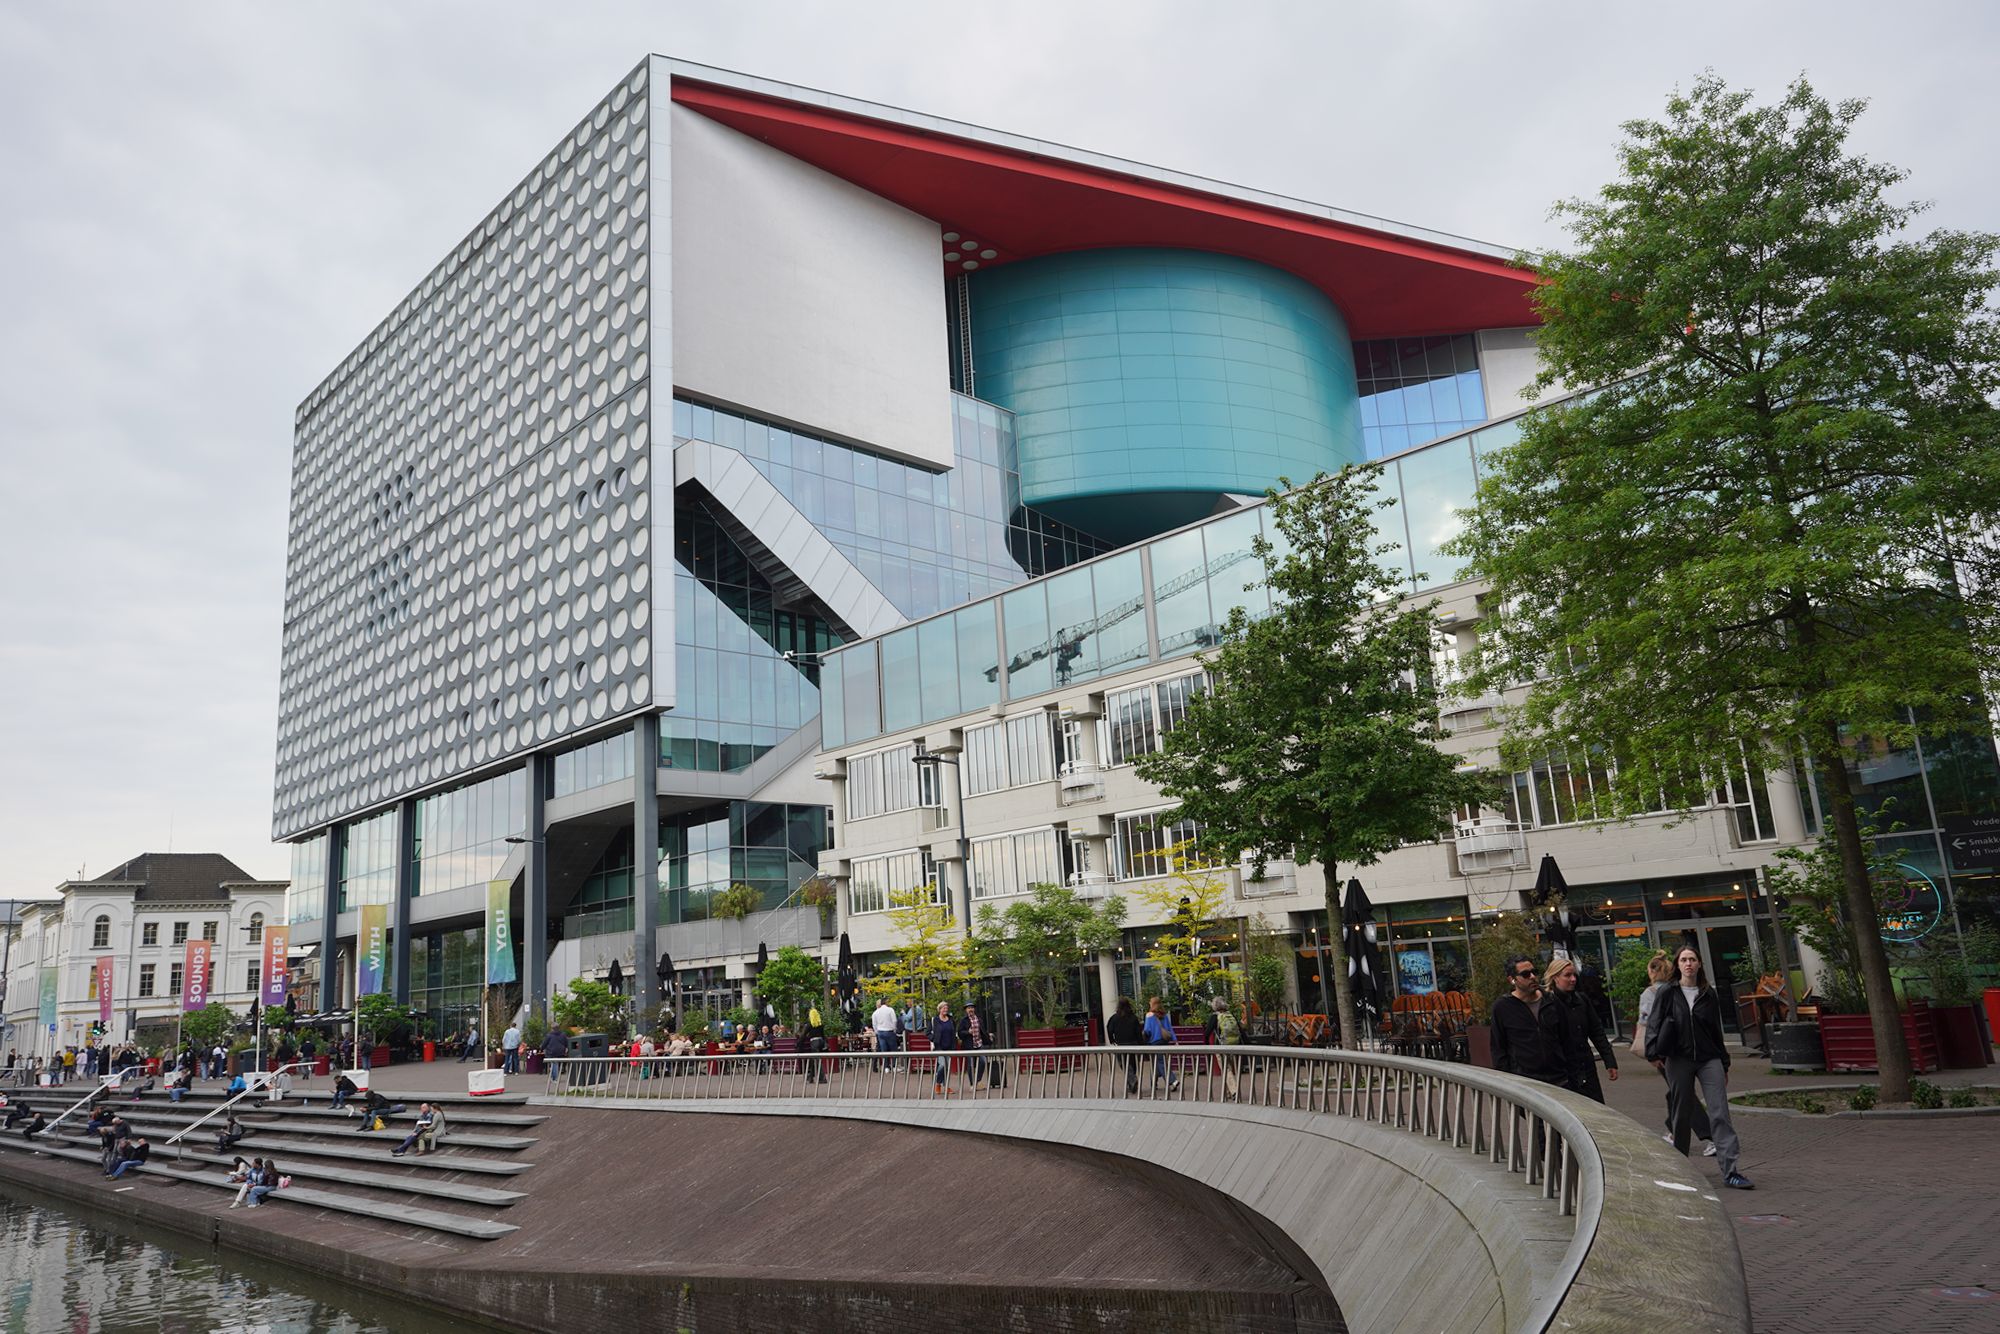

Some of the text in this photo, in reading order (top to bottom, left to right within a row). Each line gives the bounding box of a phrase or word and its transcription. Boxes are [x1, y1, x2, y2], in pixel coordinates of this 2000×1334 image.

[369, 926, 381, 972] WITH
[495, 909, 507, 953] YOU
[189, 947, 206, 1003] SOUNDS
[271, 936, 284, 994] BETTER
